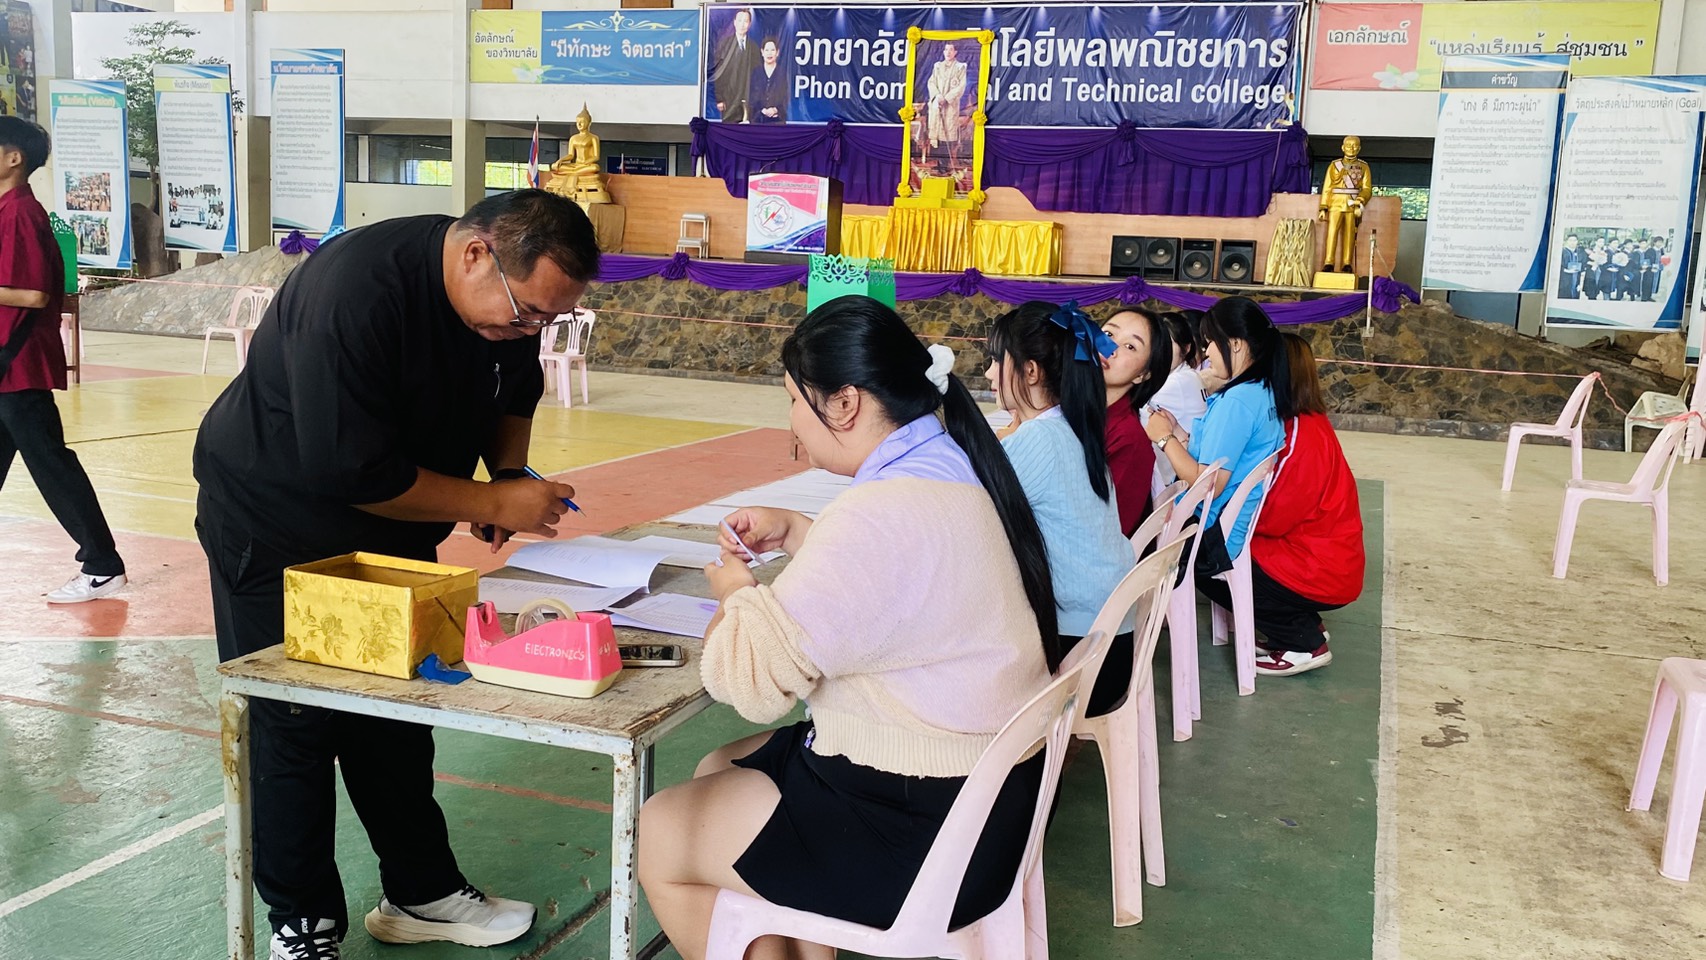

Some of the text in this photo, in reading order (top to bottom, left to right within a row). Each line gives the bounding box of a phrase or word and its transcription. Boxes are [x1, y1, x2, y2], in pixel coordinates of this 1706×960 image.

[1328, 22, 1409, 43] เอกลักษณ์
[486, 47, 538, 59] ของวิทยาลัย
[795, 27, 1288, 68] วิทยาลัยโลยีพลพณิชยการ
[1557, 32, 1627, 60] ส่ชุมชน
[795, 75, 850, 98] Phon
[1008, 77, 1053, 102] and
[1062, 77, 1181, 103] Technical
[1191, 79, 1286, 109] college
[1675, 97, 1702, 111] (Goal)
